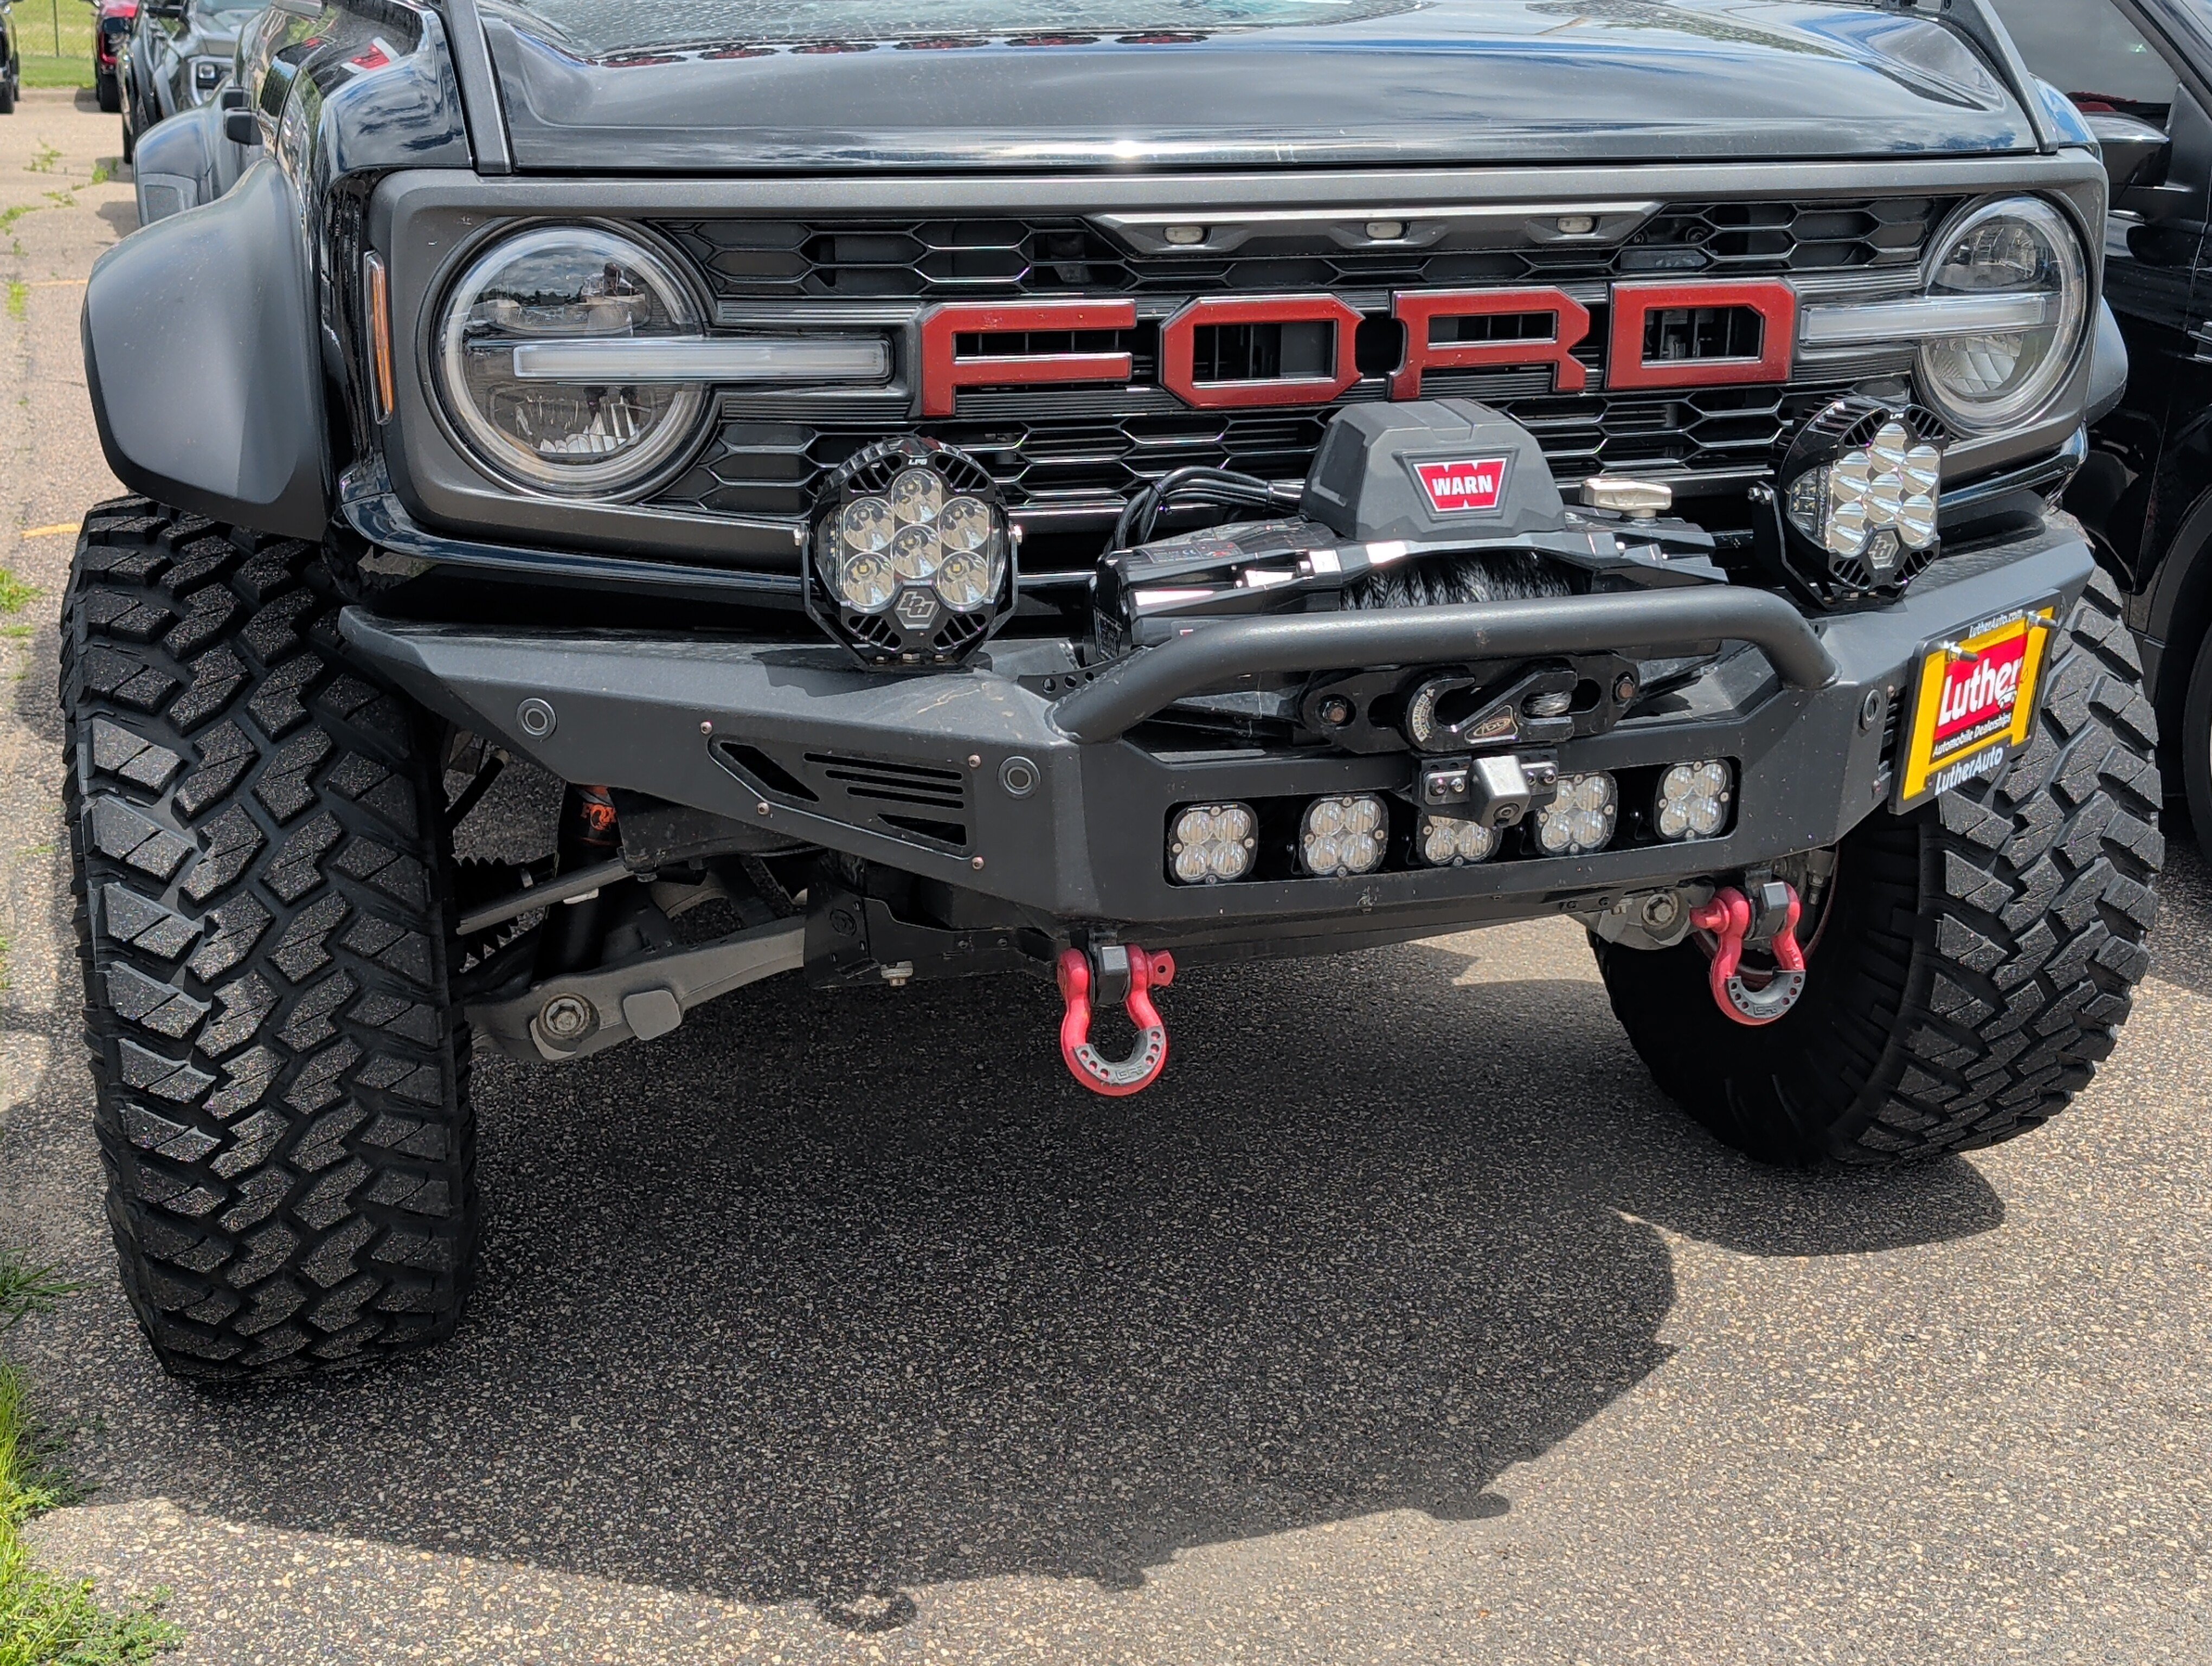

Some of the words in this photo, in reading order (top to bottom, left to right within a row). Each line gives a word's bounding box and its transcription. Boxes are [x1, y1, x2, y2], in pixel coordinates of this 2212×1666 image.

[921, 277, 1793, 417] FORD
[1431, 474, 1494, 497] WARN
[1938, 656, 2024, 727] Luther
[1934, 746, 2004, 796] LutherAuto
